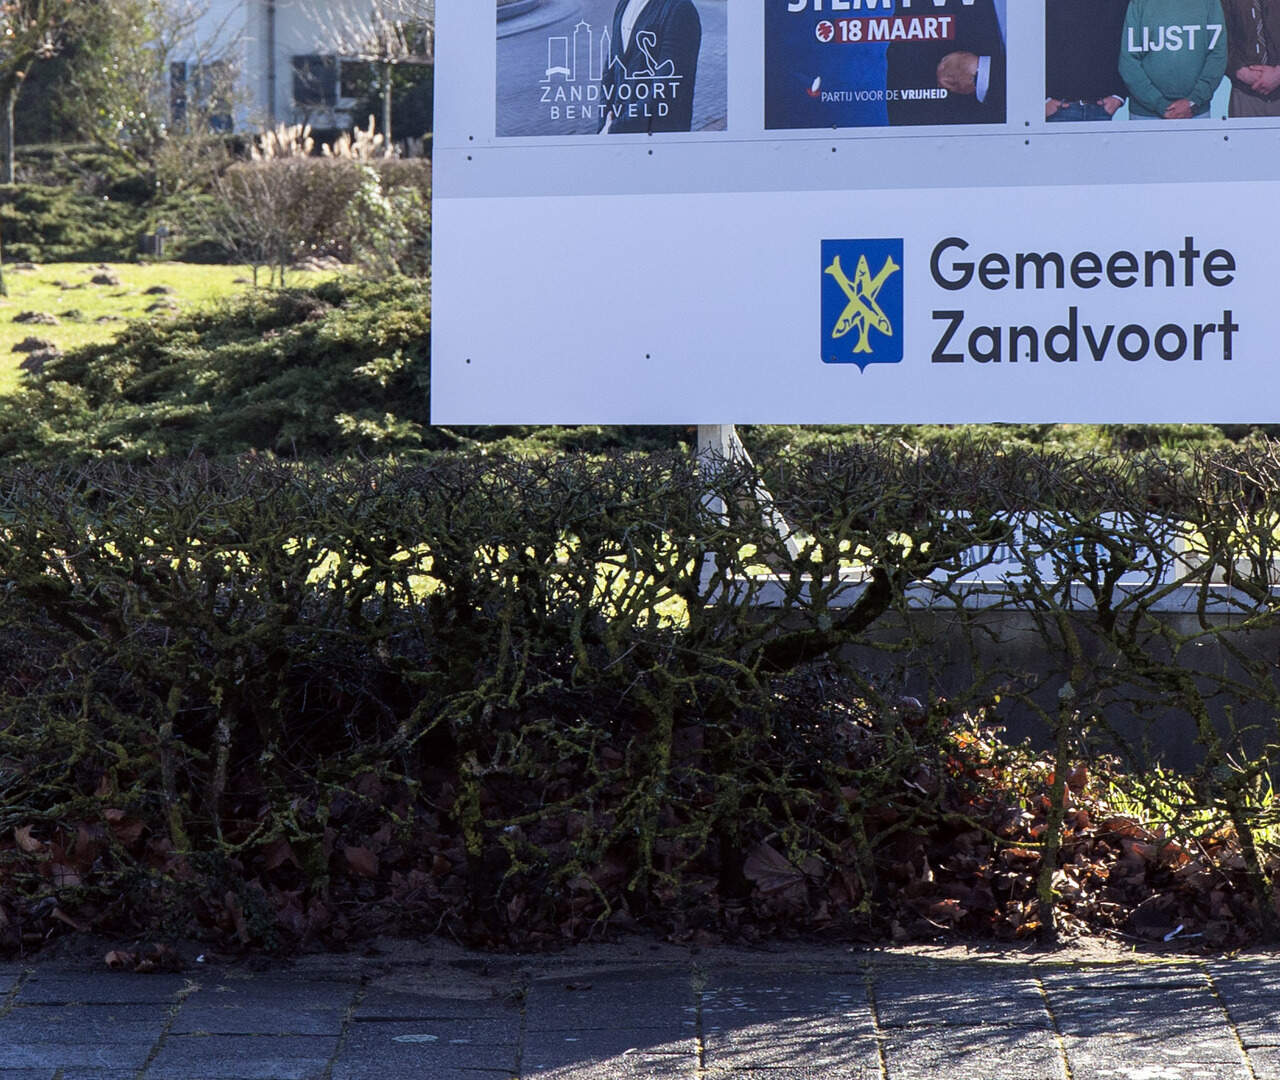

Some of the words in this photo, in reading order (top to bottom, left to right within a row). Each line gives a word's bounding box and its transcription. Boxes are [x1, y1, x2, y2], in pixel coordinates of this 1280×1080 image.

[838, 20, 862, 41] 18
[867, 17, 951, 41] MAART
[1127, 25, 1200, 52] LIJST
[1206, 24, 1222, 50] 7
[540, 82, 680, 103] ZANDVOORT
[821, 91, 852, 102] PARTIJ
[854, 90, 883, 101] VOOR
[886, 90, 899, 100] DE
[901, 88, 948, 100] VRIJHEID
[550, 102, 669, 120] BENTVELD
[930, 236, 1236, 291] Gemeente
[931, 306, 1239, 363] Zandvoort
